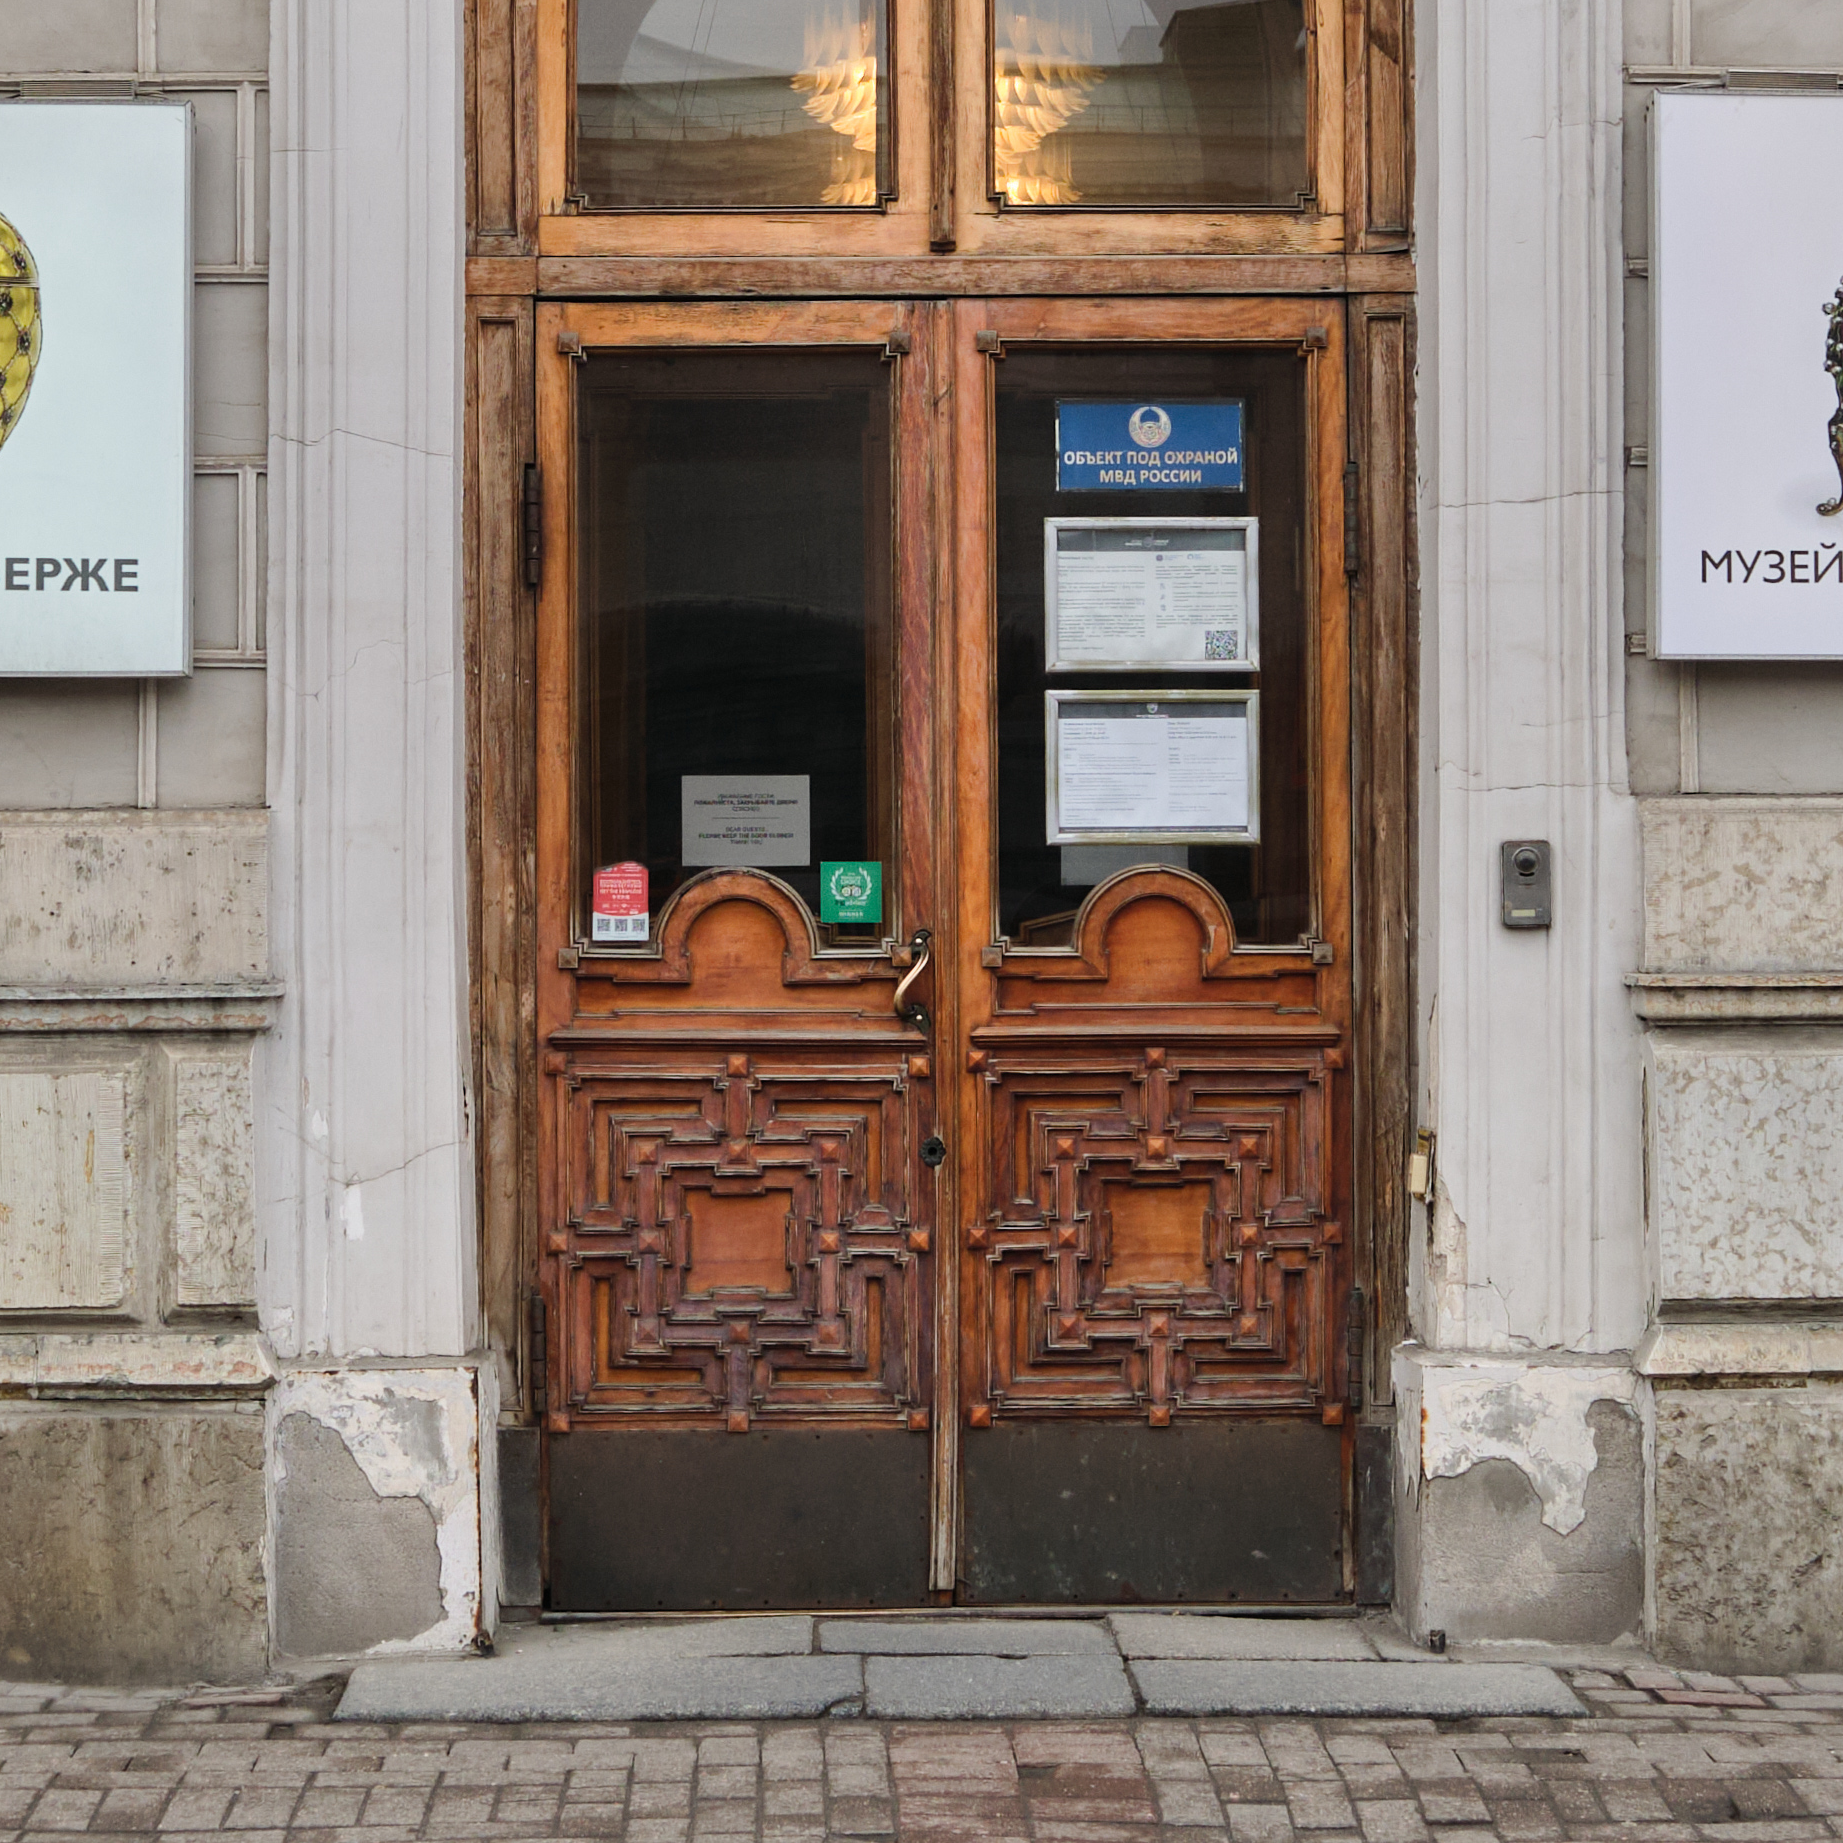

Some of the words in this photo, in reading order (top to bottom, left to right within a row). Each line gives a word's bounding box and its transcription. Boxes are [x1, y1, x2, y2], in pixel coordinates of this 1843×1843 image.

[1064, 450, 1123, 465] ОБЪЕКТ
[1126, 450, 1161, 468] ПОД
[1164, 447, 1238, 465] ОХРАНОЙ
[1099, 469, 1137, 486] МВД
[1139, 469, 1202, 483] РОССИИ
[1701, 543, 1843, 584] МУЗЕЙ
